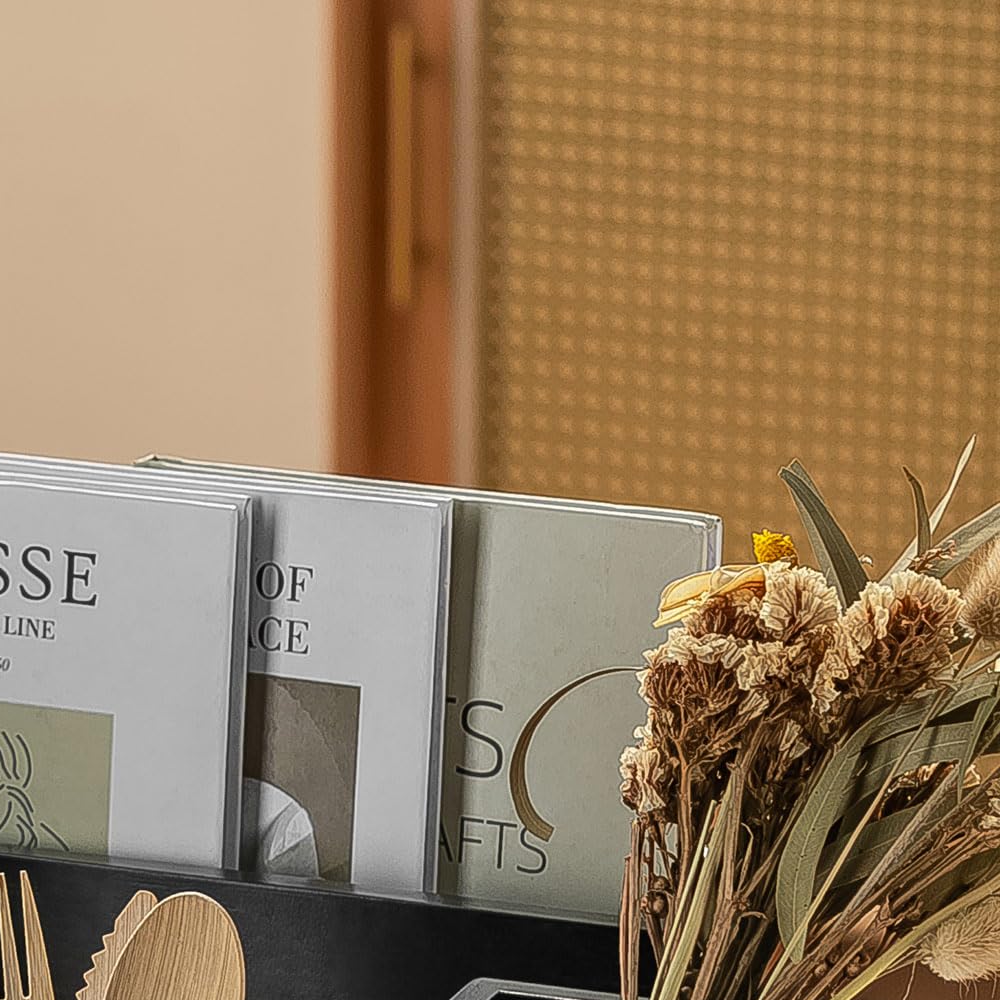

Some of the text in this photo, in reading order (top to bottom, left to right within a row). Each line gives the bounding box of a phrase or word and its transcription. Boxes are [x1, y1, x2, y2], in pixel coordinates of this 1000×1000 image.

[256, 562, 313, 602] OF
[4, 615, 56, 639] LINE
[446, 696, 504, 778] S
